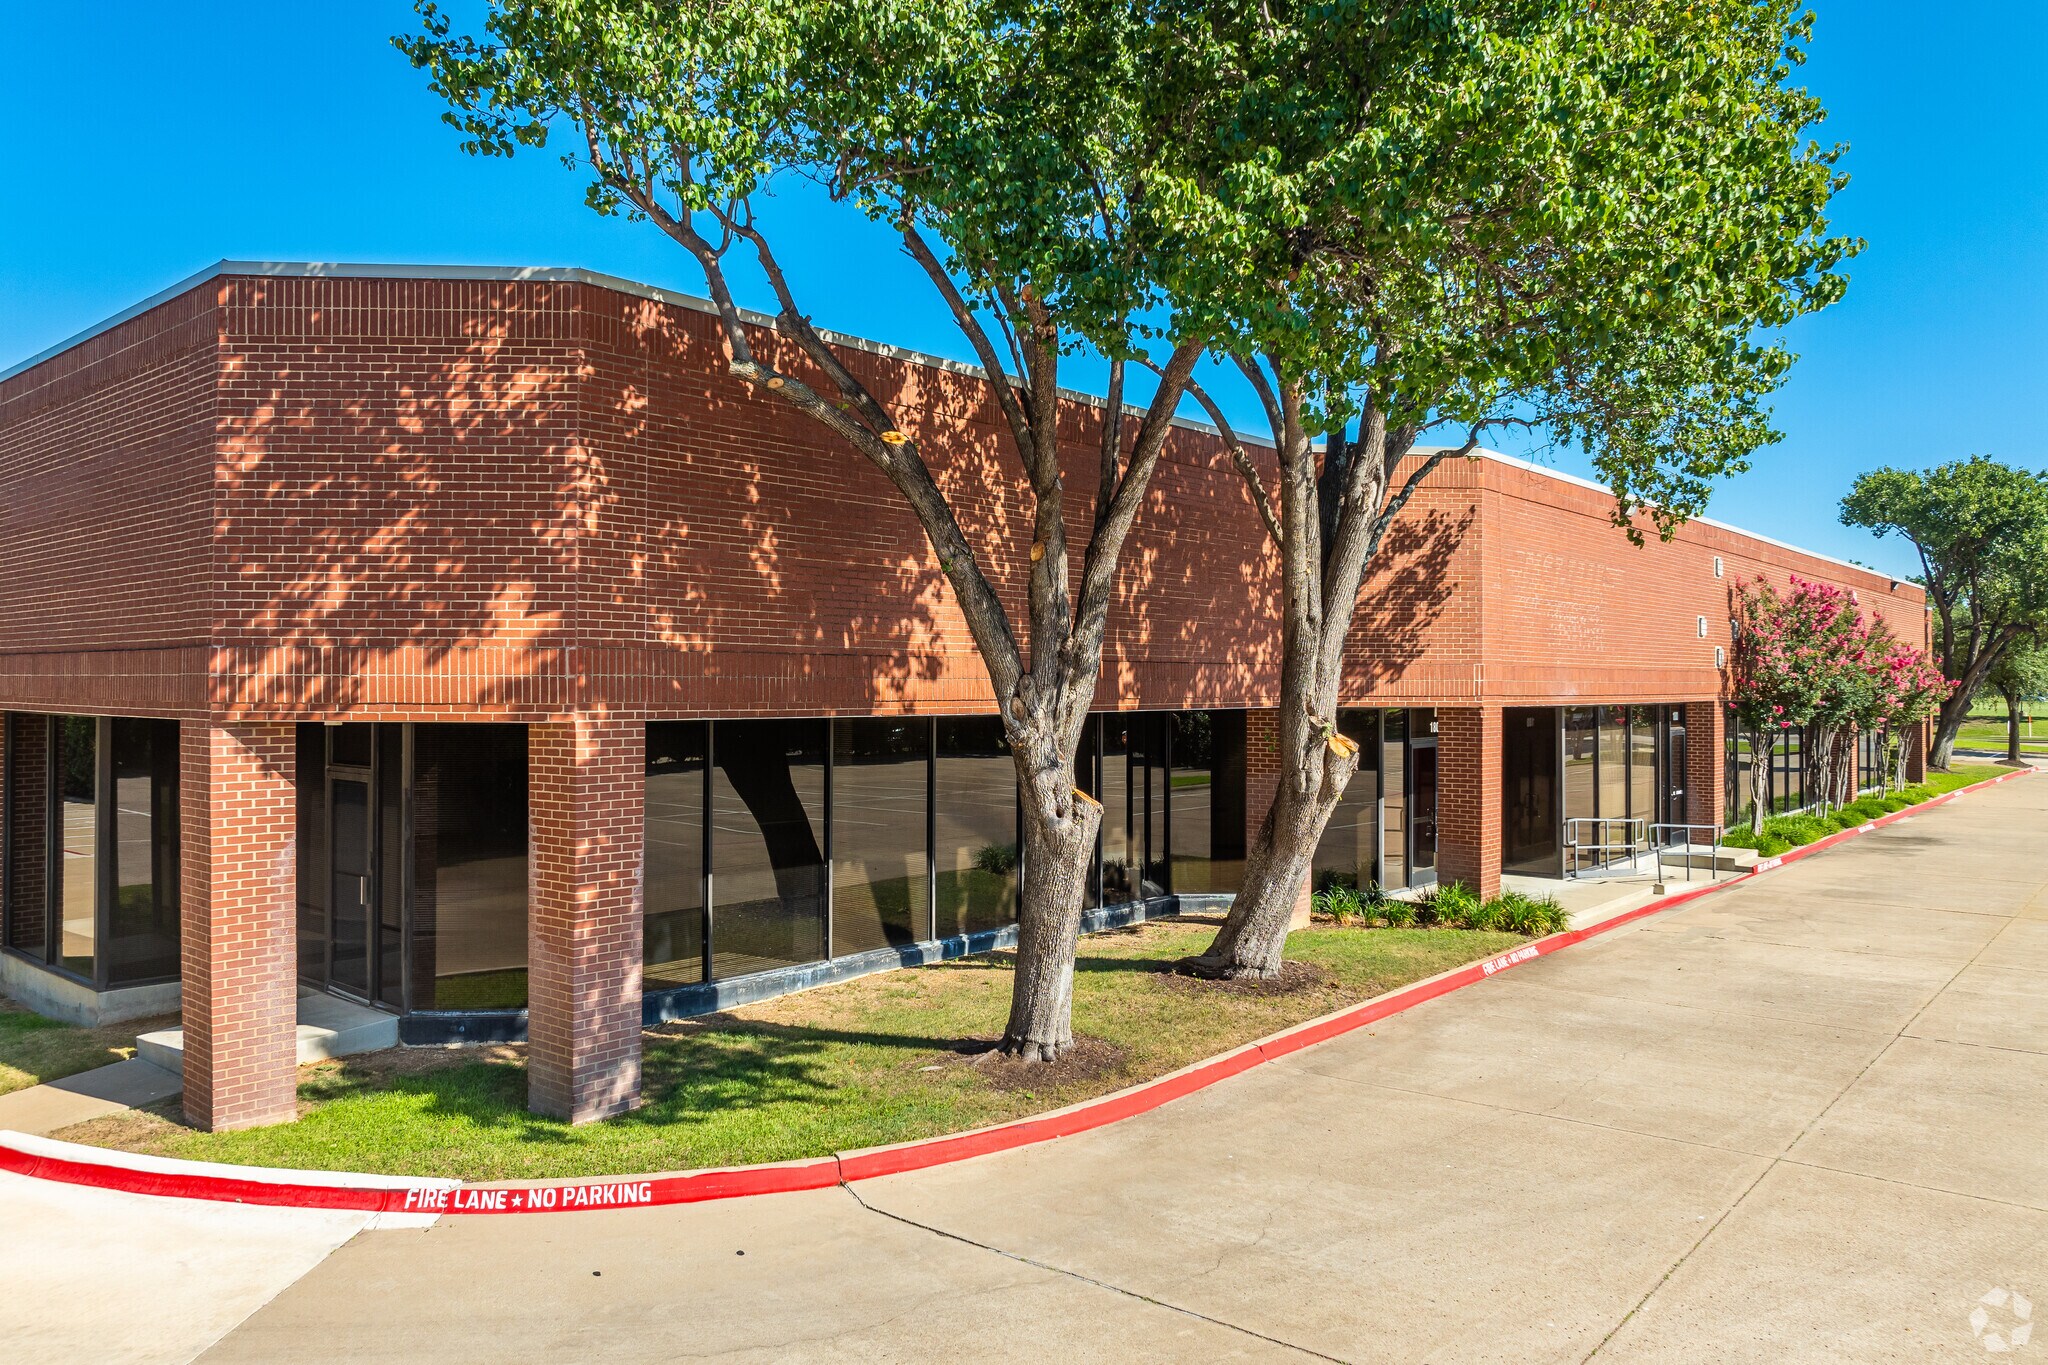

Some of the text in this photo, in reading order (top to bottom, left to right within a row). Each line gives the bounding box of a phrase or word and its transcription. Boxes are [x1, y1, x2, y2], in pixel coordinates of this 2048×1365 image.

[404, 1182, 652, 1209] FIRE LANE NO PARKING
